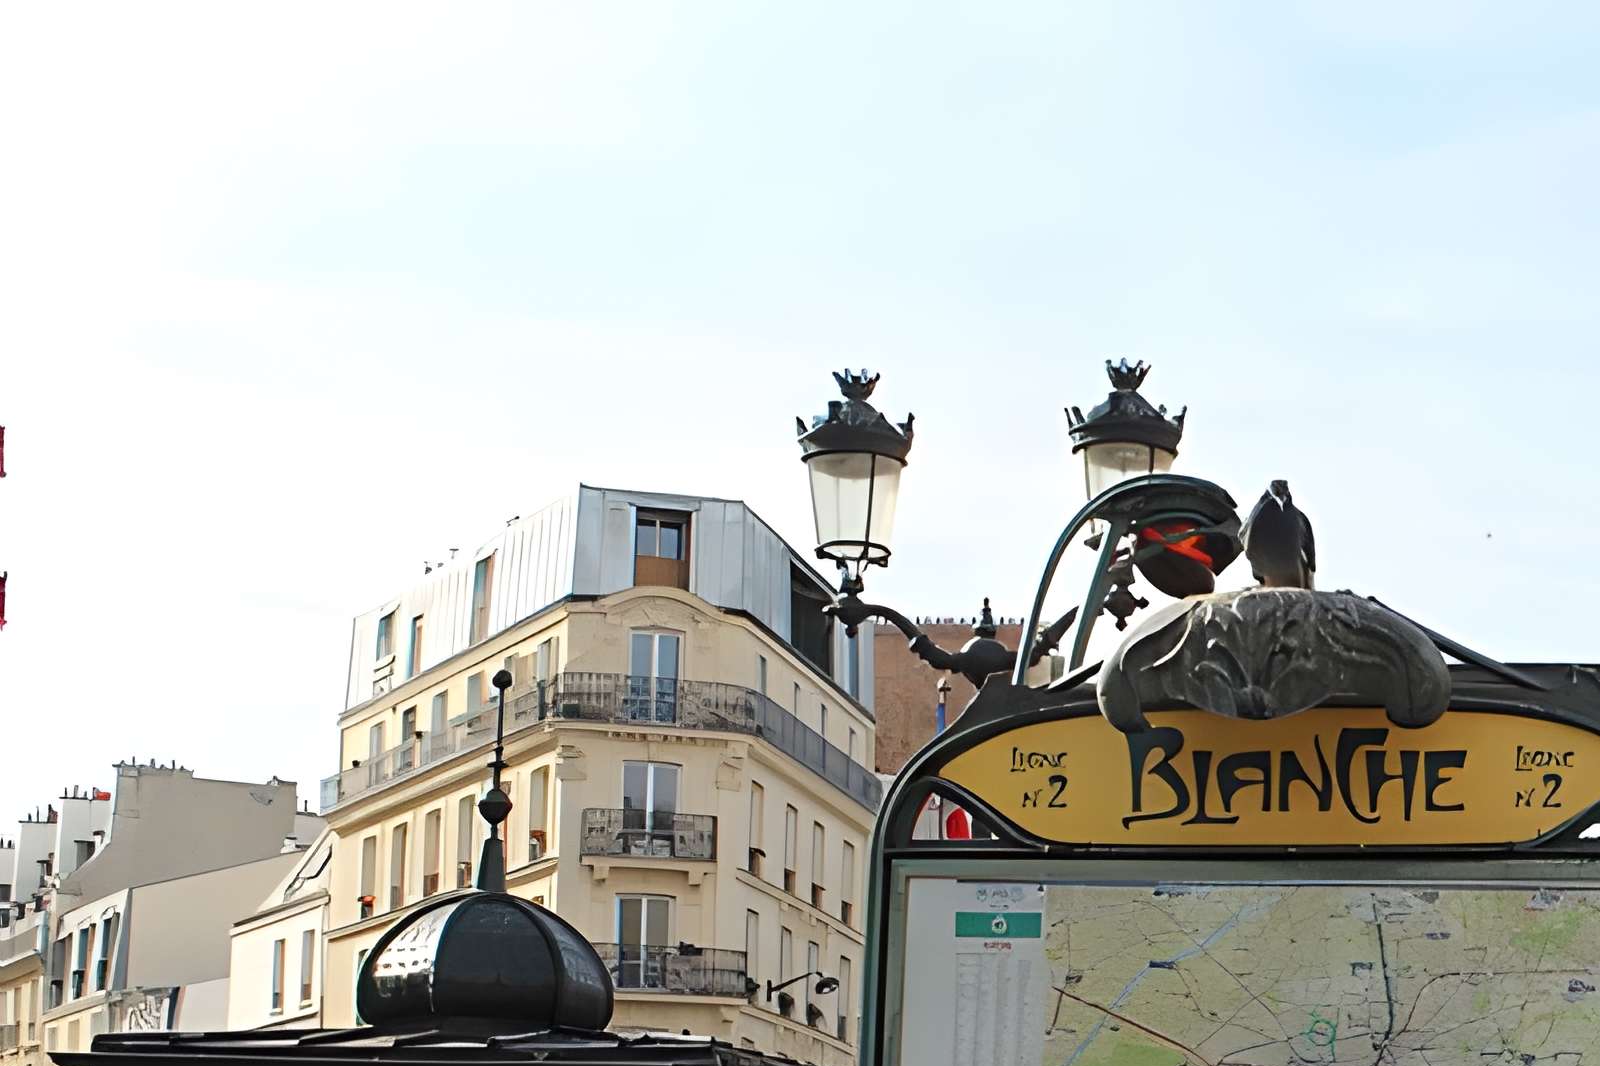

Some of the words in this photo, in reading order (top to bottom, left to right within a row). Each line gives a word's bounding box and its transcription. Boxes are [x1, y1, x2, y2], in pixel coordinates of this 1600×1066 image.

[1047, 774, 1068, 808] 2
[1121, 726, 1468, 830] BLANCHE
[1542, 773, 1563, 808] 2
